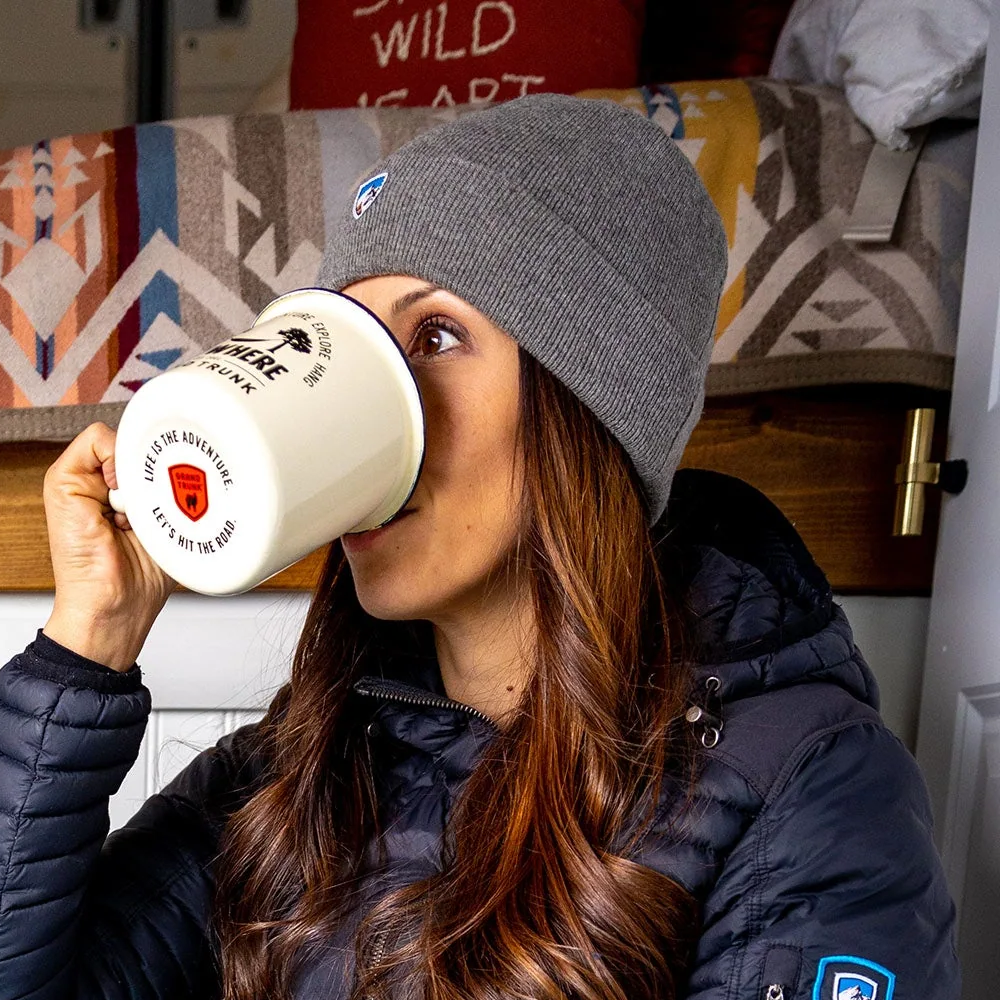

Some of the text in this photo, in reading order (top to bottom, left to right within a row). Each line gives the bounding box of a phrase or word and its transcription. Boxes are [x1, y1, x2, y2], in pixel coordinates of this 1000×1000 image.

[370, 1, 517, 68] WILD
[197, 361, 257, 394] TRUNK
[303, 321, 332, 388] EXPLORE HANG
[144, 430, 234, 491] LIFE IS THE ADVENTURE.
[152, 506, 237, 554] LET'S HIT THE ROAD.
